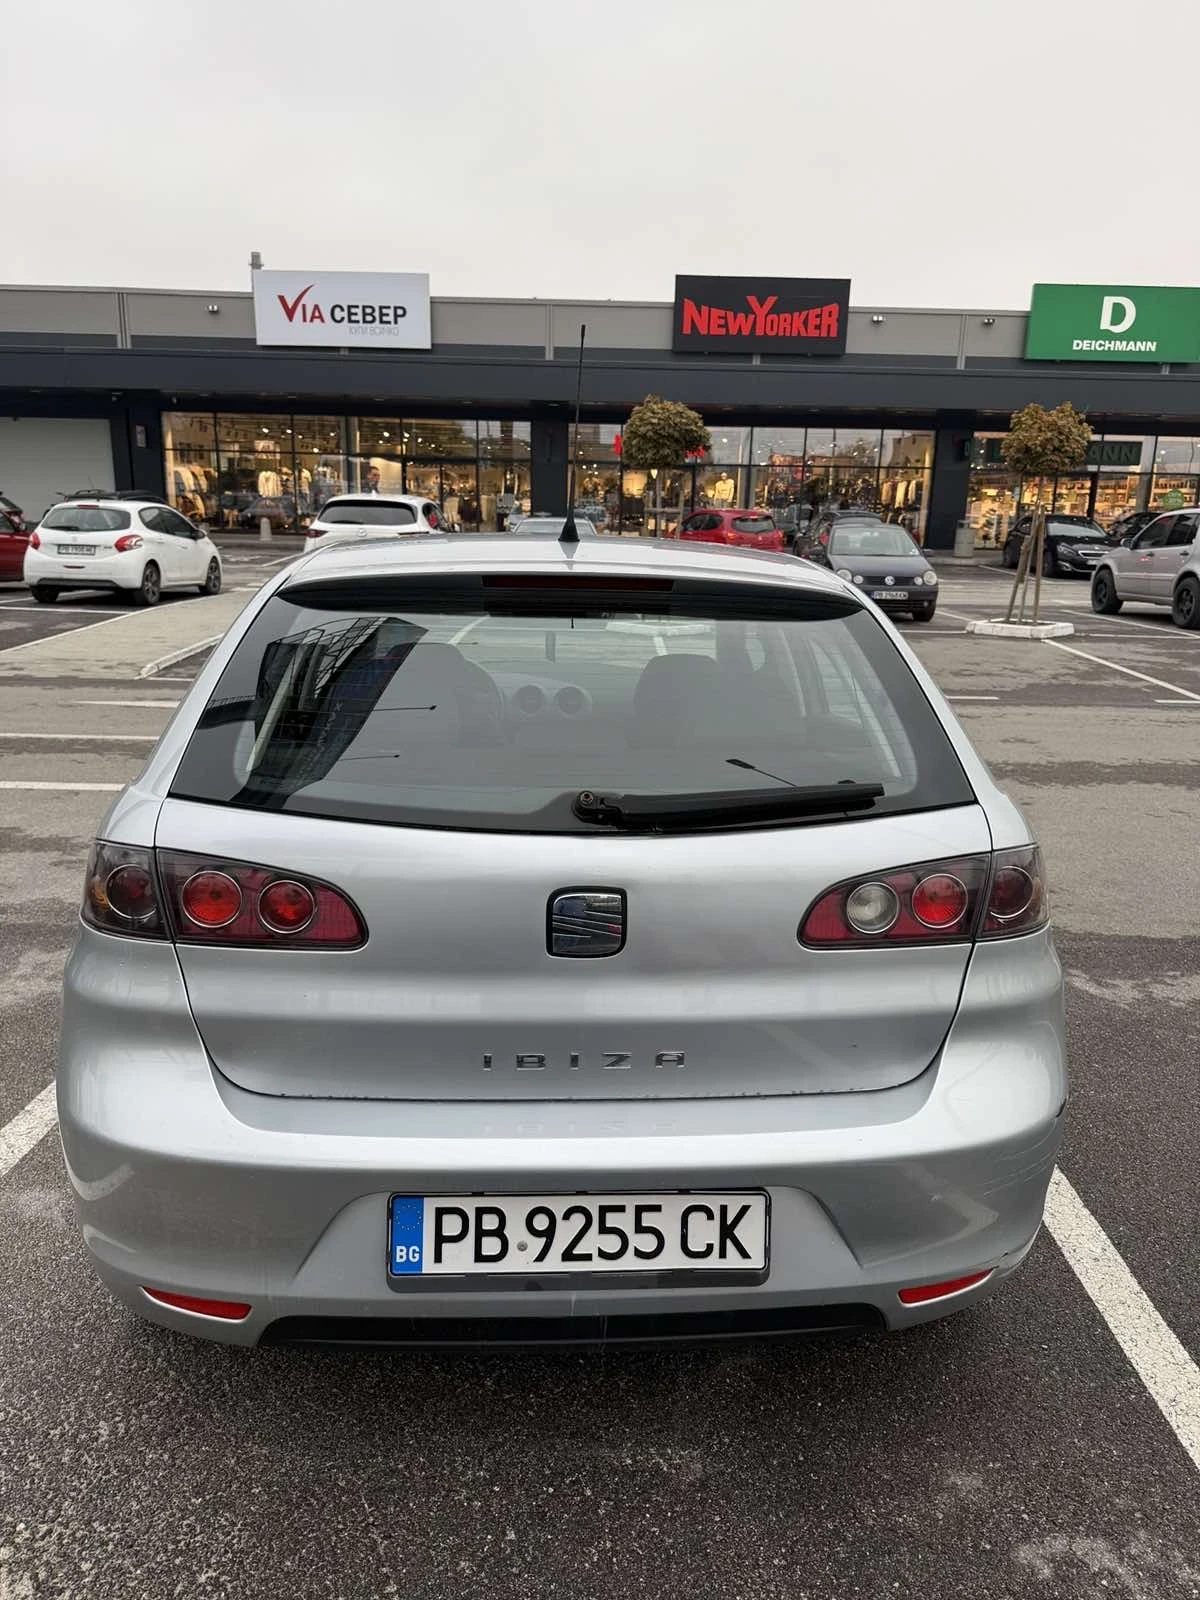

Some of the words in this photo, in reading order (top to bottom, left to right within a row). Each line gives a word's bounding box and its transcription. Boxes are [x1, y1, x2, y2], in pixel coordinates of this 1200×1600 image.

[277, 284, 326, 323] VIA
[330, 304, 407, 325] СЕВЕР
[1100, 296, 1136, 333] D
[1072, 340, 1157, 352] DEICHMANN
[482, 1051, 685, 1071] IBIZA
[433, 1205, 509, 1264] PB
[525, 1203, 666, 1263] 9255
[680, 1203, 753, 1260] CK
[395, 1245, 420, 1263] BG
